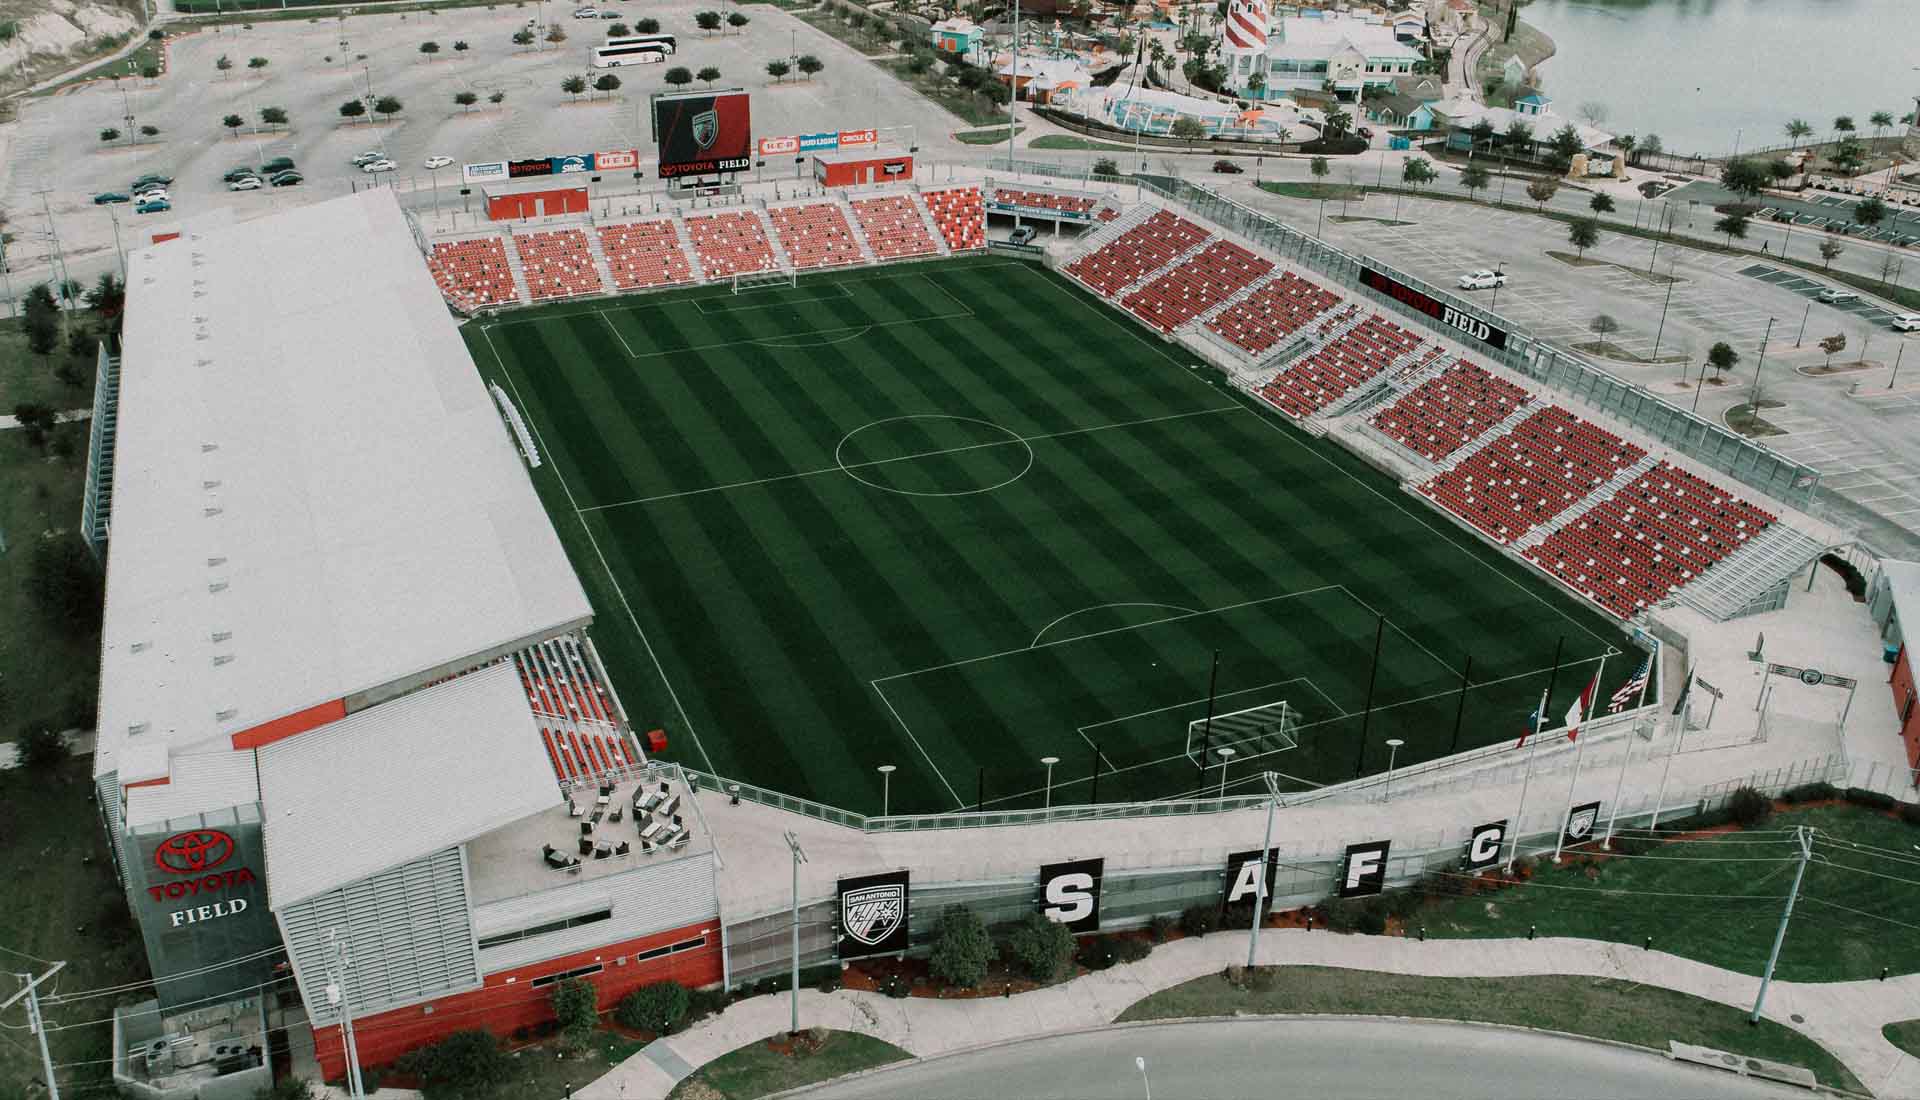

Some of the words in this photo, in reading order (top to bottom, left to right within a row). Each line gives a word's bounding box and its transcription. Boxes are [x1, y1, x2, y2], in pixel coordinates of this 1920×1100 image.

[520, 163, 551, 172] TOYOTA
[675, 162, 715, 173] TOYOTA
[719, 158, 749, 170] FIELD
[1391, 283, 1440, 317] TOYOTA
[1442, 306, 1490, 341] FIELD
[1470, 828, 1502, 863] C
[147, 866, 256, 902] TOYOTA
[1228, 860, 1270, 902] A
[1346, 850, 1382, 889] F
[170, 898, 248, 927] FIELD
[850, 895, 865, 903] SAN
[866, 891, 897, 901] ANTONIO
[1045, 872, 1094, 924] S
